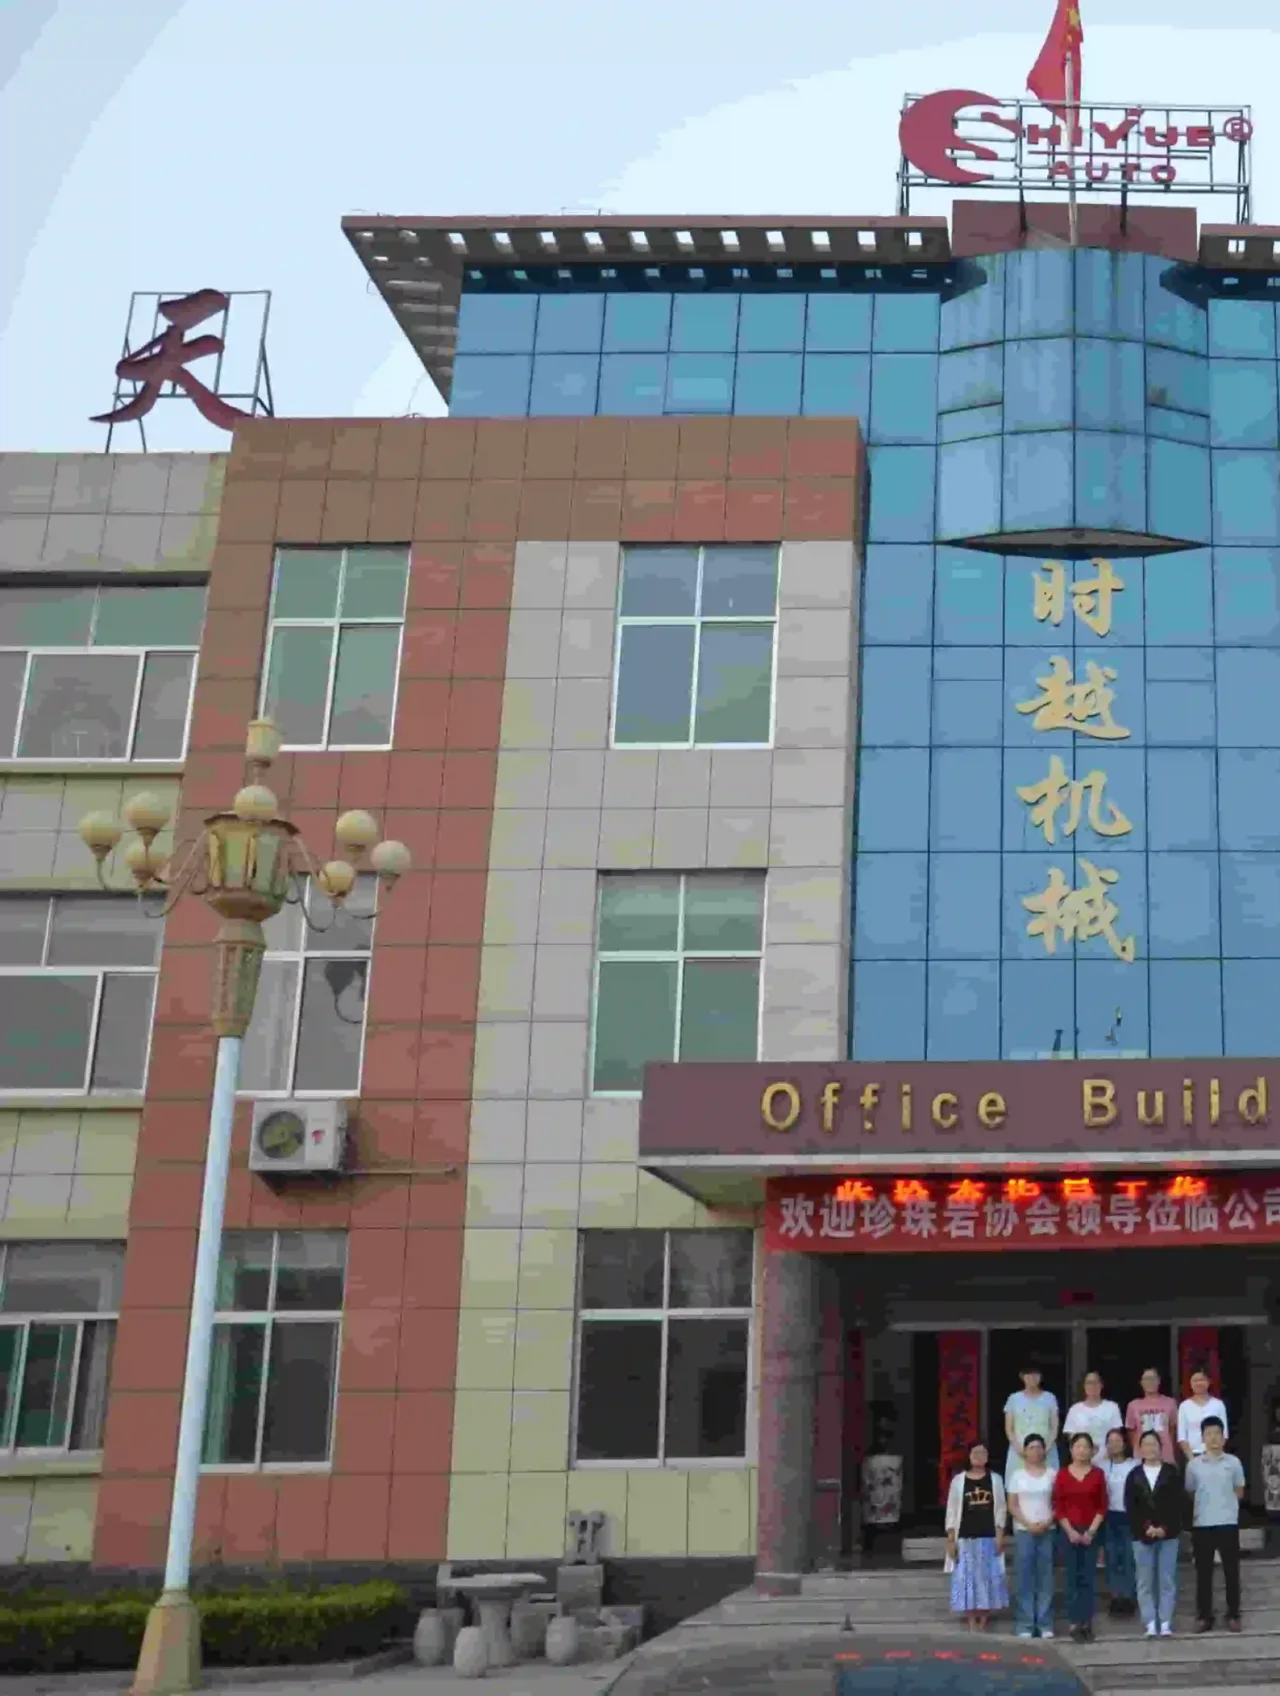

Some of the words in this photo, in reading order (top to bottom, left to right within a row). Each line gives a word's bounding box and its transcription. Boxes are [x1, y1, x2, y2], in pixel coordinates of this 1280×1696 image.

[1049, 161, 1176, 183] AUTO
[1016, 557, 1135, 964] 时越机械
[761, 1082, 1007, 1131] Office
